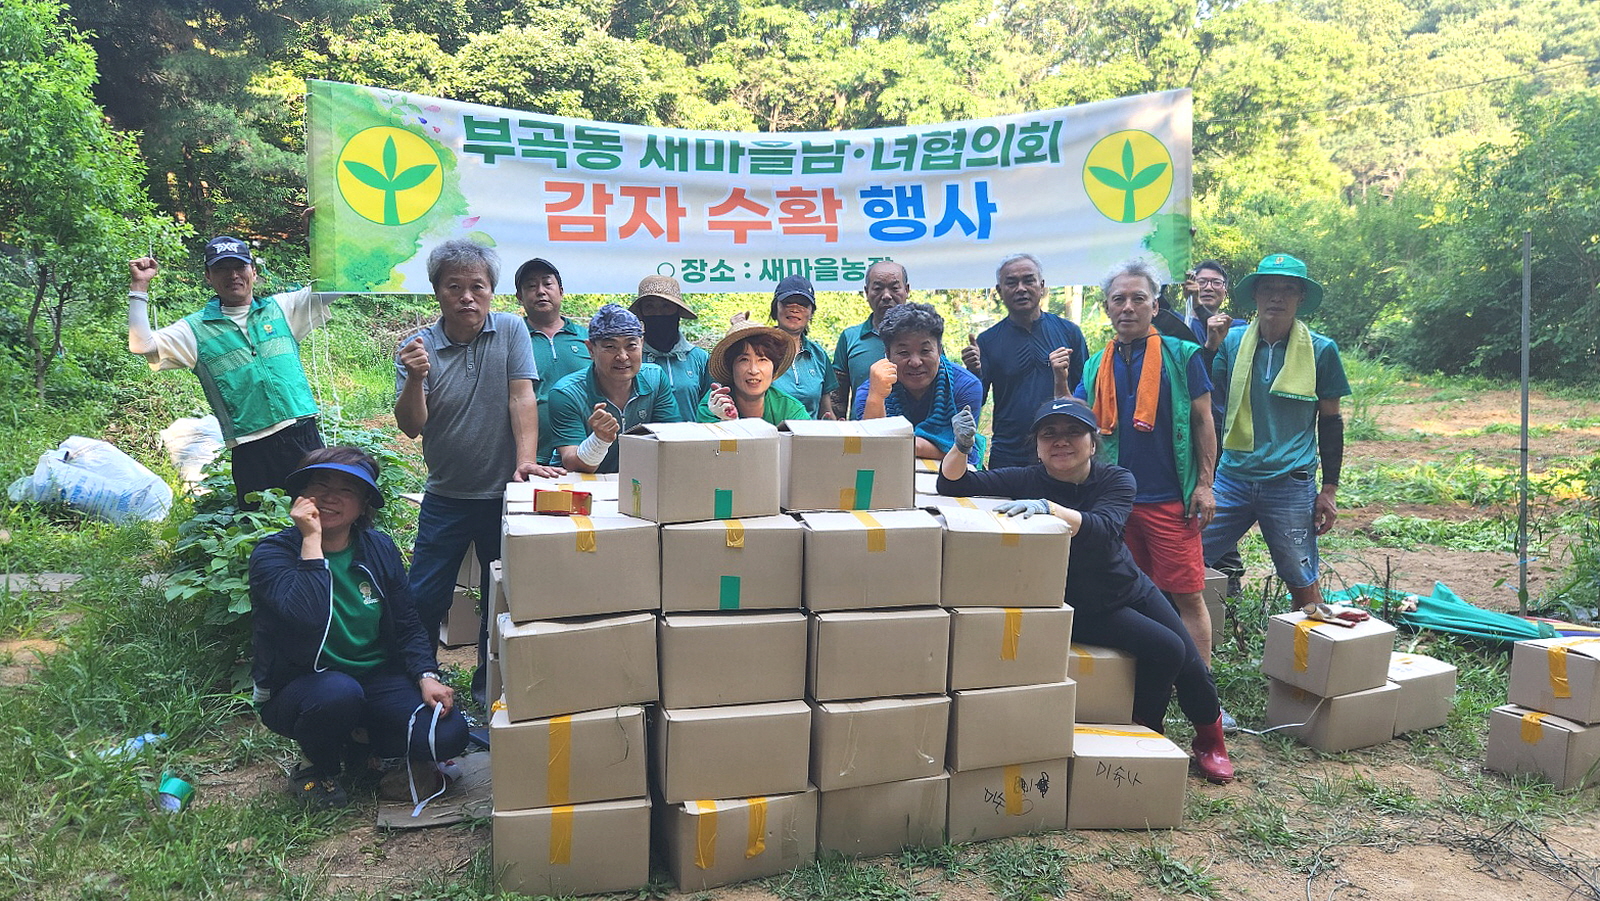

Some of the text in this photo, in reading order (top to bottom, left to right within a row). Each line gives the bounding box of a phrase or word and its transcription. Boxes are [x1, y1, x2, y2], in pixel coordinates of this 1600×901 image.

[463, 114, 1063, 175] 부곡동 새마을남·녀협의회
[544, 180, 998, 244] 감자 수확 행사
[681, 258, 736, 283] 장소
